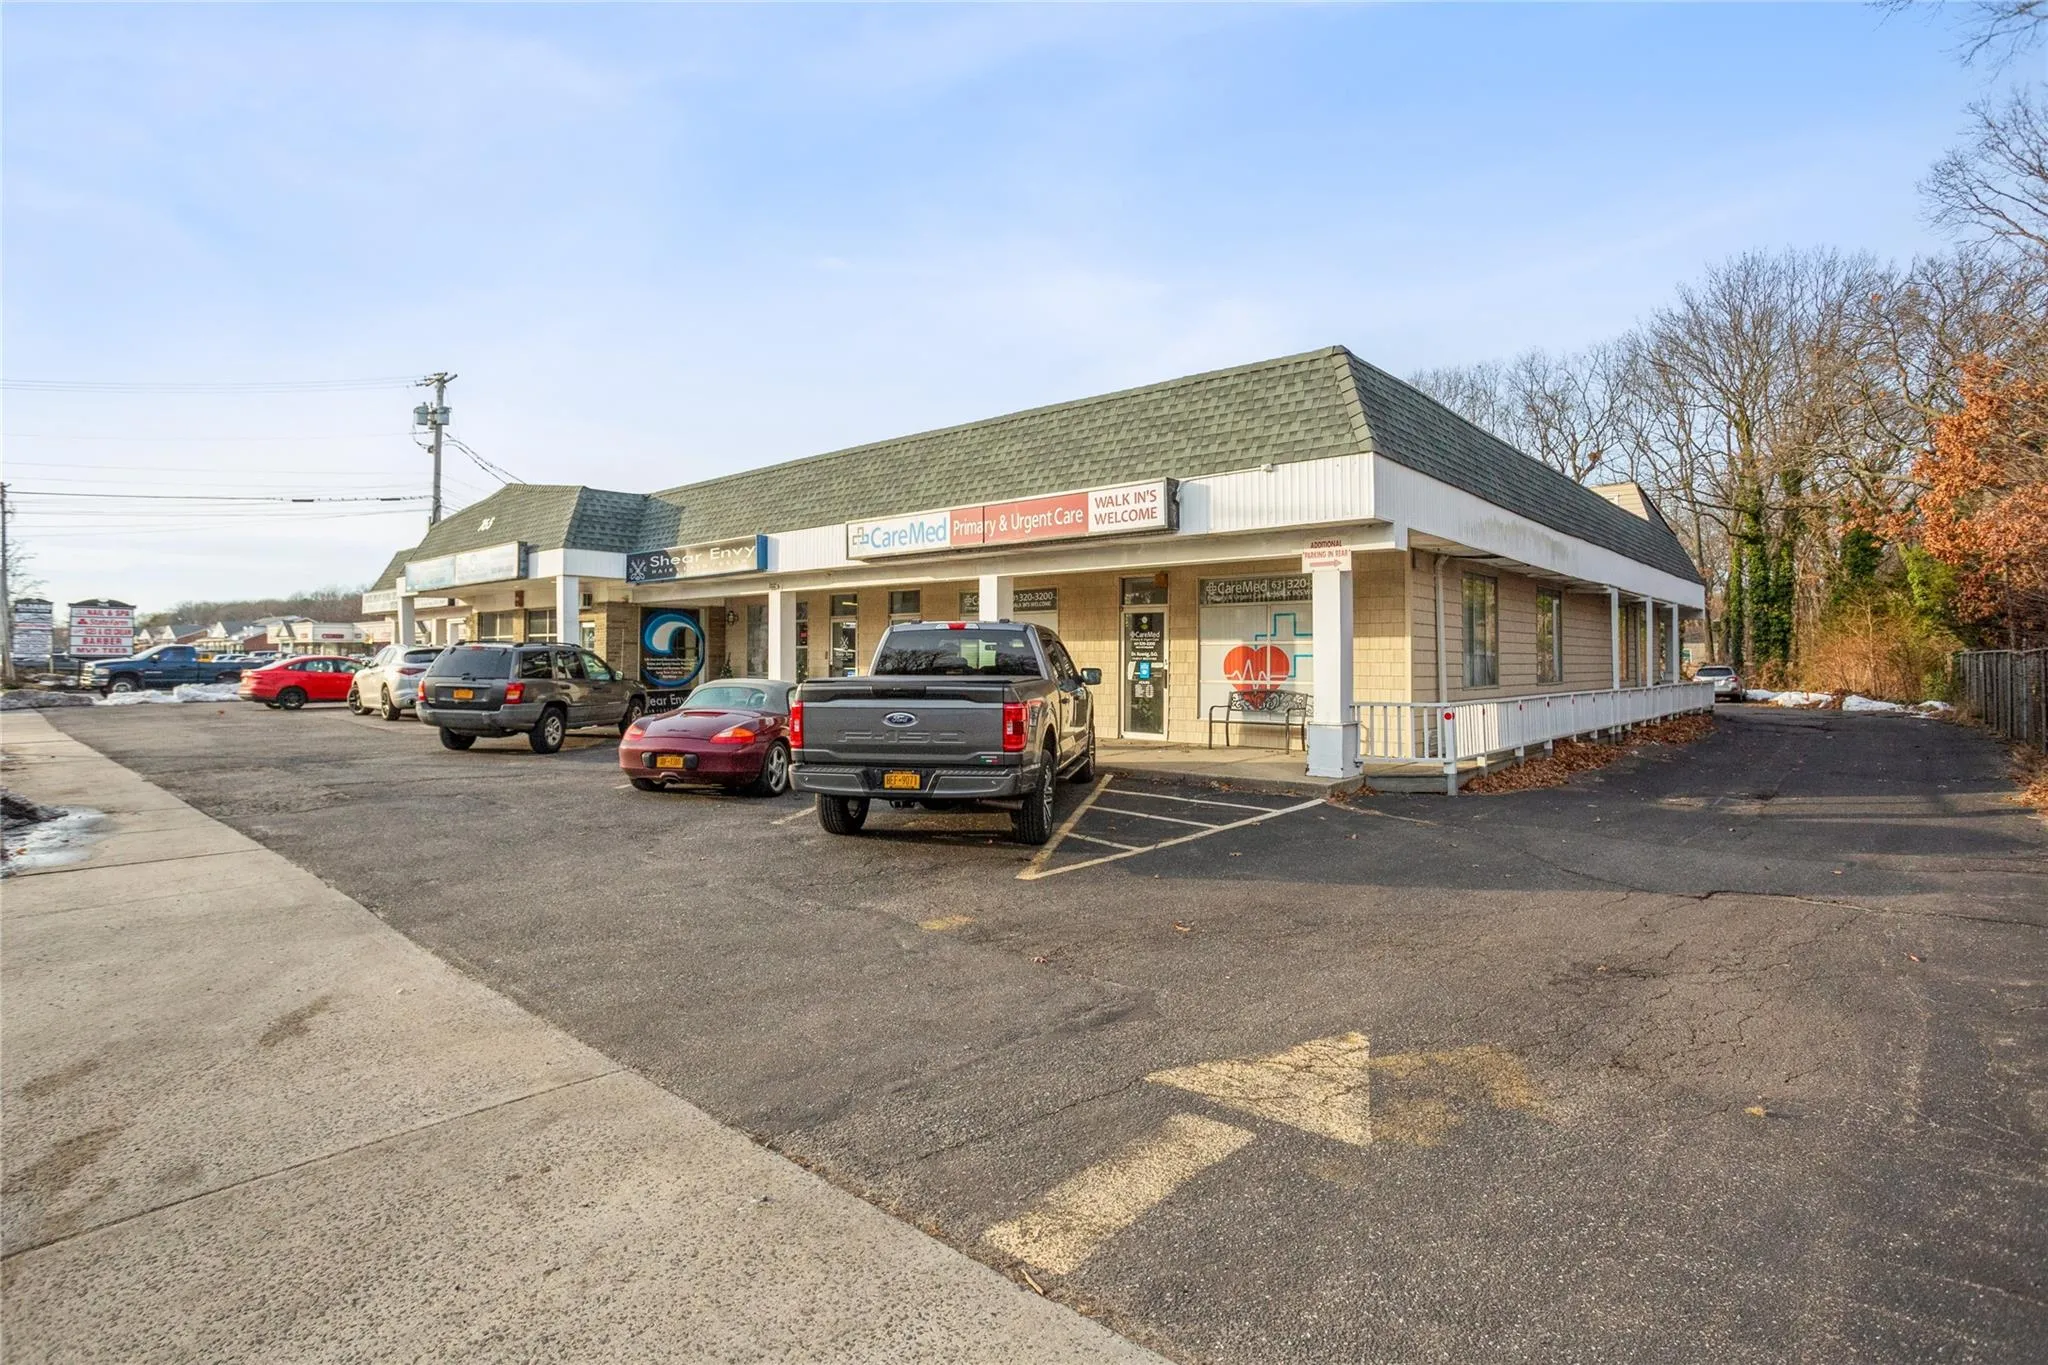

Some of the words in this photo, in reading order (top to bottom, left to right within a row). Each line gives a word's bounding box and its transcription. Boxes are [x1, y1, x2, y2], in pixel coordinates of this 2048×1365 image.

[1094, 493, 1130, 508] WALK
[1134, 490, 1157, 504] IN'S
[1094, 507, 1158, 525] WELCOME
[871, 517, 947, 548] CareMed
[953, 519, 996, 537] Primary
[998, 514, 1007, 532] &
[1011, 511, 1052, 533] Urgent
[1054, 507, 1083, 525] Care
[1310, 540, 1342, 548] ADDITIONAL
[650, 553, 702, 567] Shear
[710, 545, 755, 560] Envy
[1304, 550, 1327, 559] PARKING
[1328, 550, 1334, 558] IN
[1217, 580, 1267, 594] CareMed
[1019, 591, 1053, 601] 320-3200
[82, 637, 122, 645] BARBER
[891, 714, 908, 723] Ford
